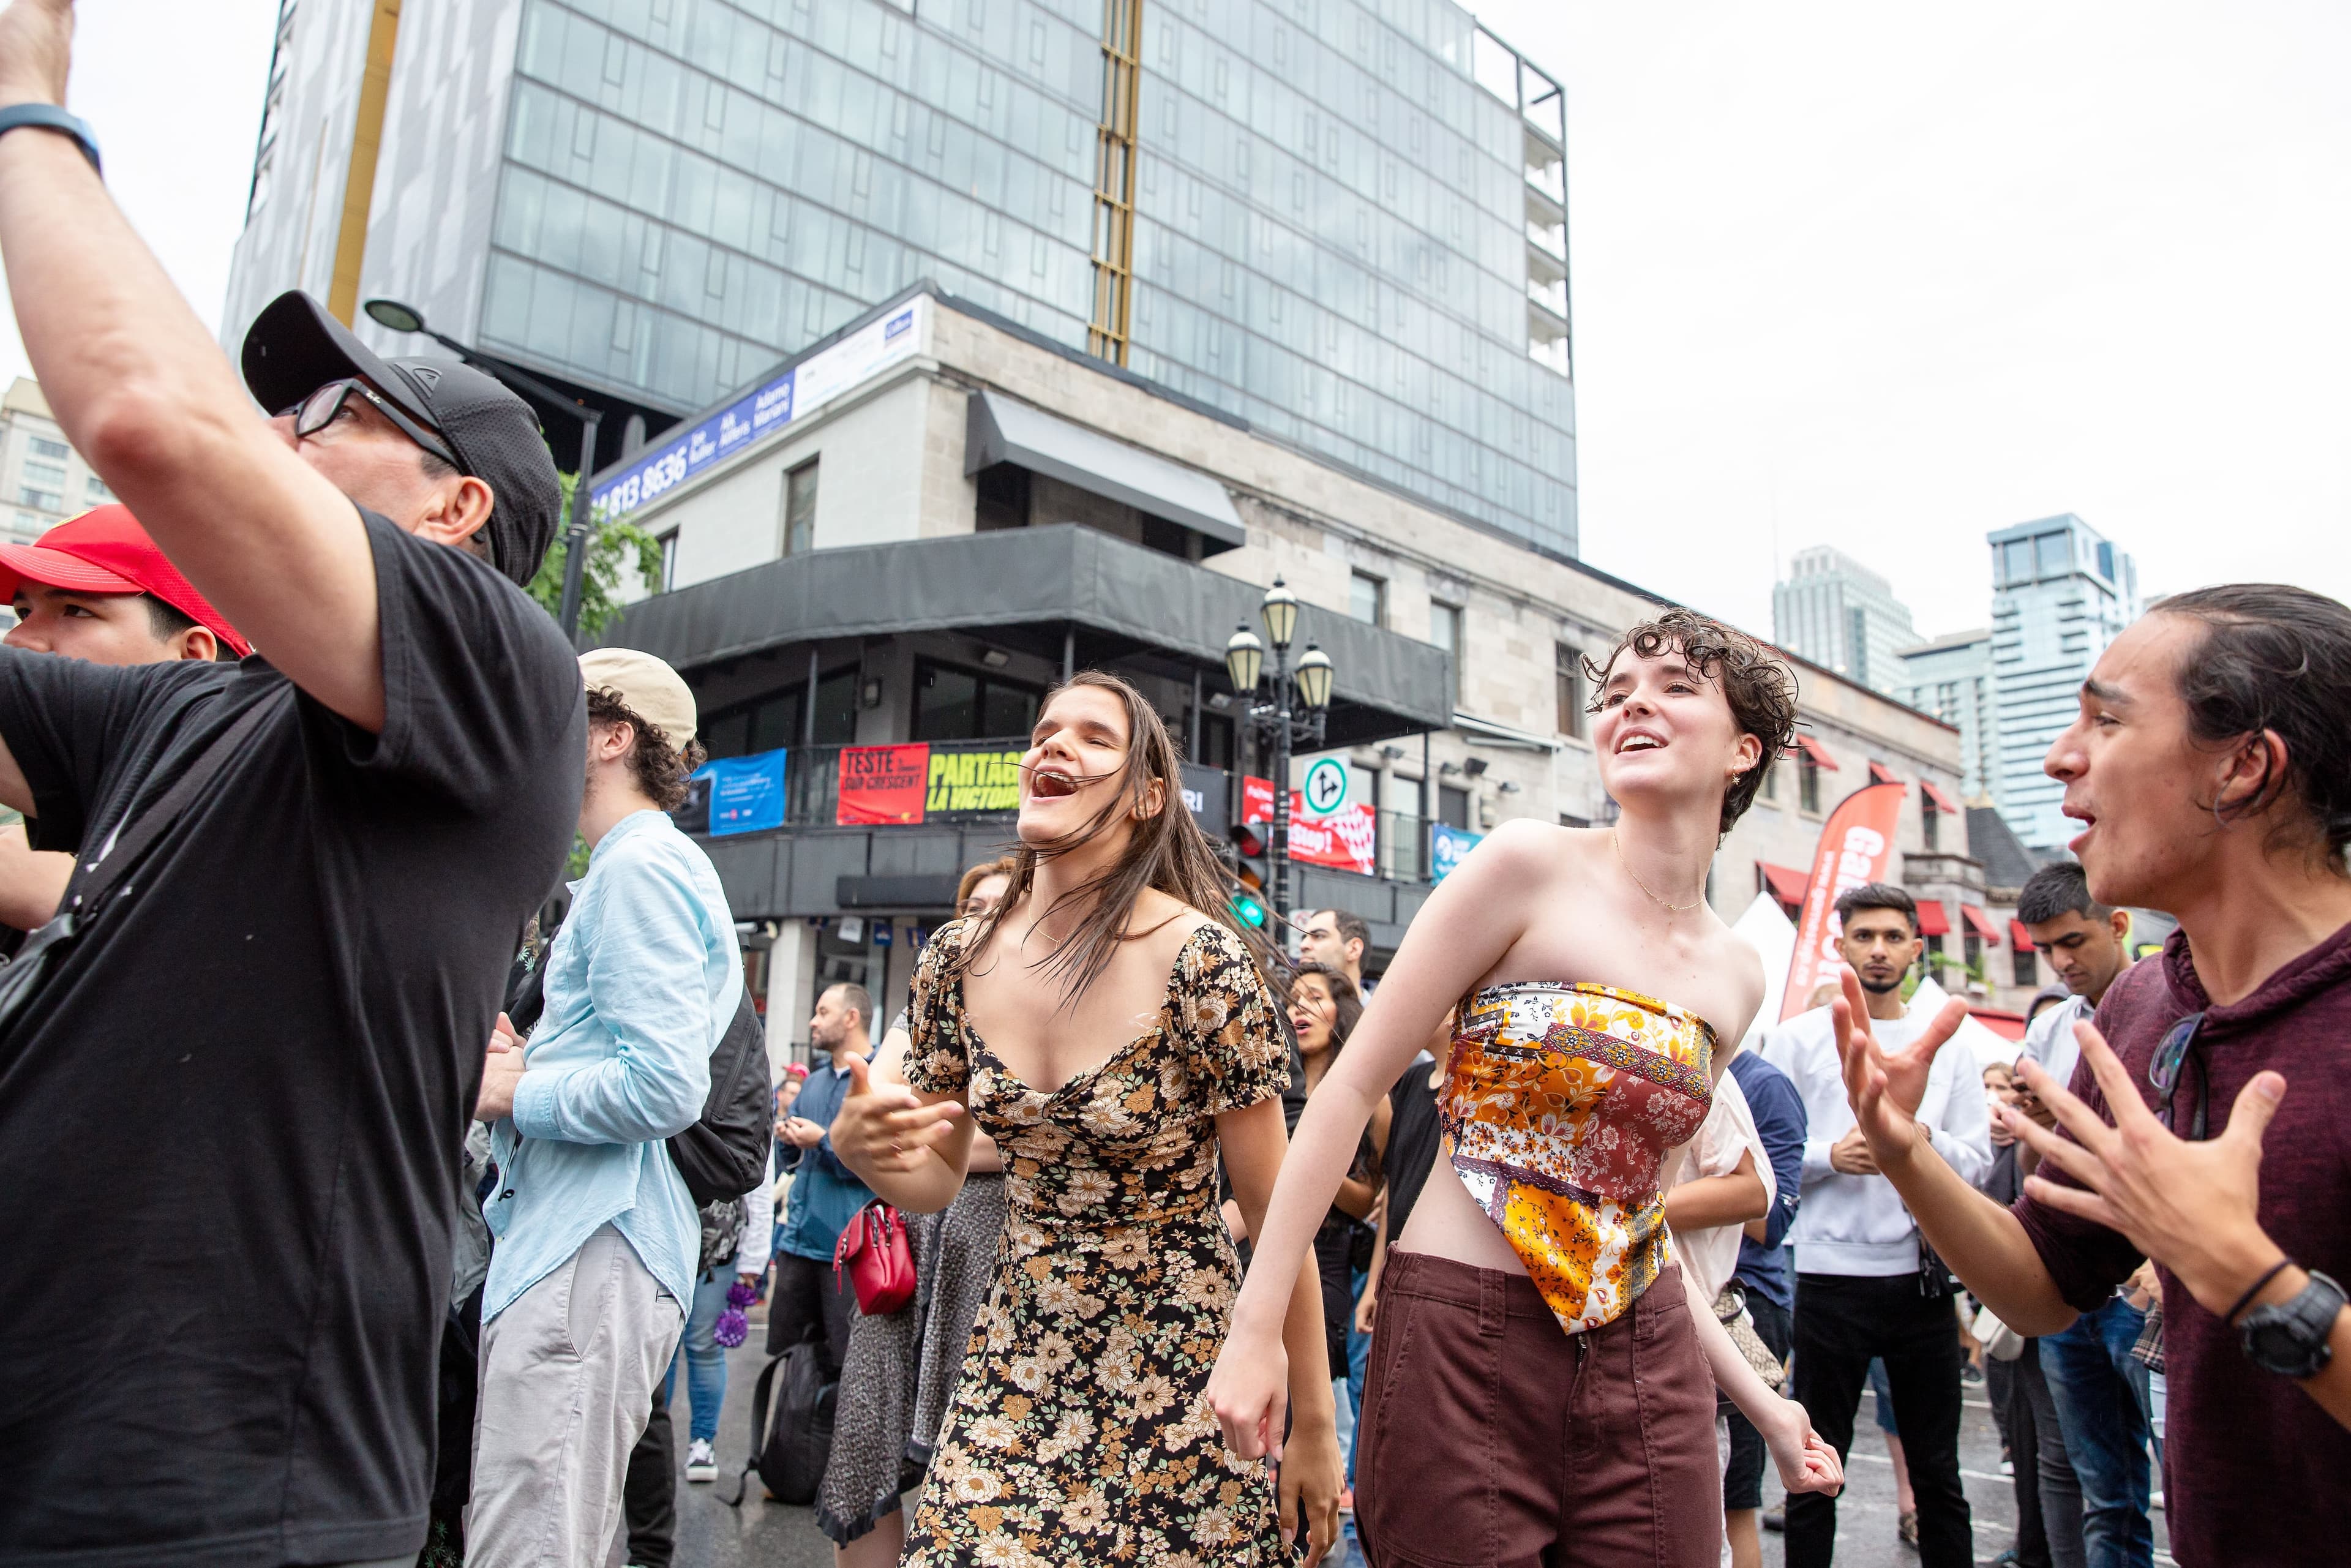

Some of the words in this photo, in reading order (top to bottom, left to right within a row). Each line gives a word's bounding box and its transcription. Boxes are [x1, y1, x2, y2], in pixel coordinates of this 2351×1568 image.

[609, 475, 640, 517] 813
[640, 445, 687, 500] 8636
[847, 751, 894, 773] TESTE
[926, 786, 949, 812] LA
